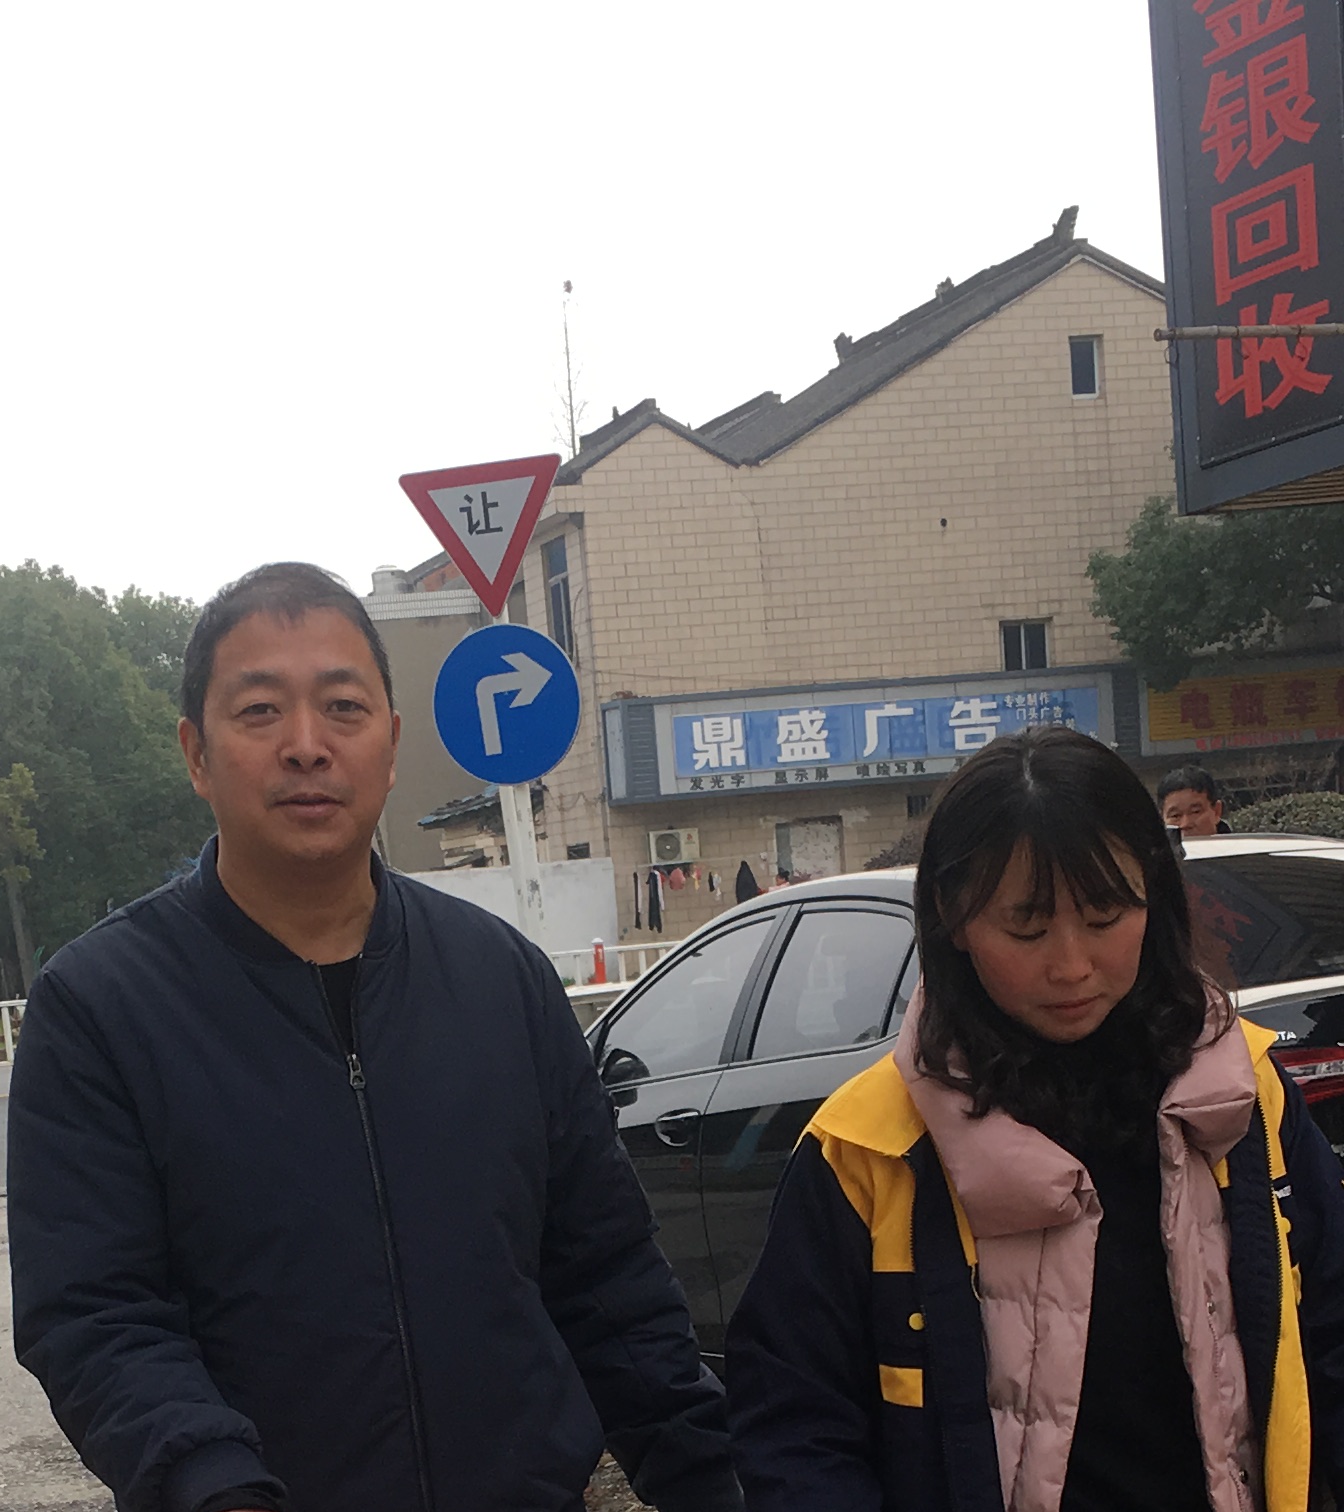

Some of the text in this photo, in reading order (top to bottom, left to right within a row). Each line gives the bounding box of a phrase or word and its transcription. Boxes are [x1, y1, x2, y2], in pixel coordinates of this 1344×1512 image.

[459, 491, 503, 536] 让
[692, 698, 1001, 771] 鼎盛广告
[690, 773, 746, 790] 发光字
[775, 768, 829, 785] 显示屏
